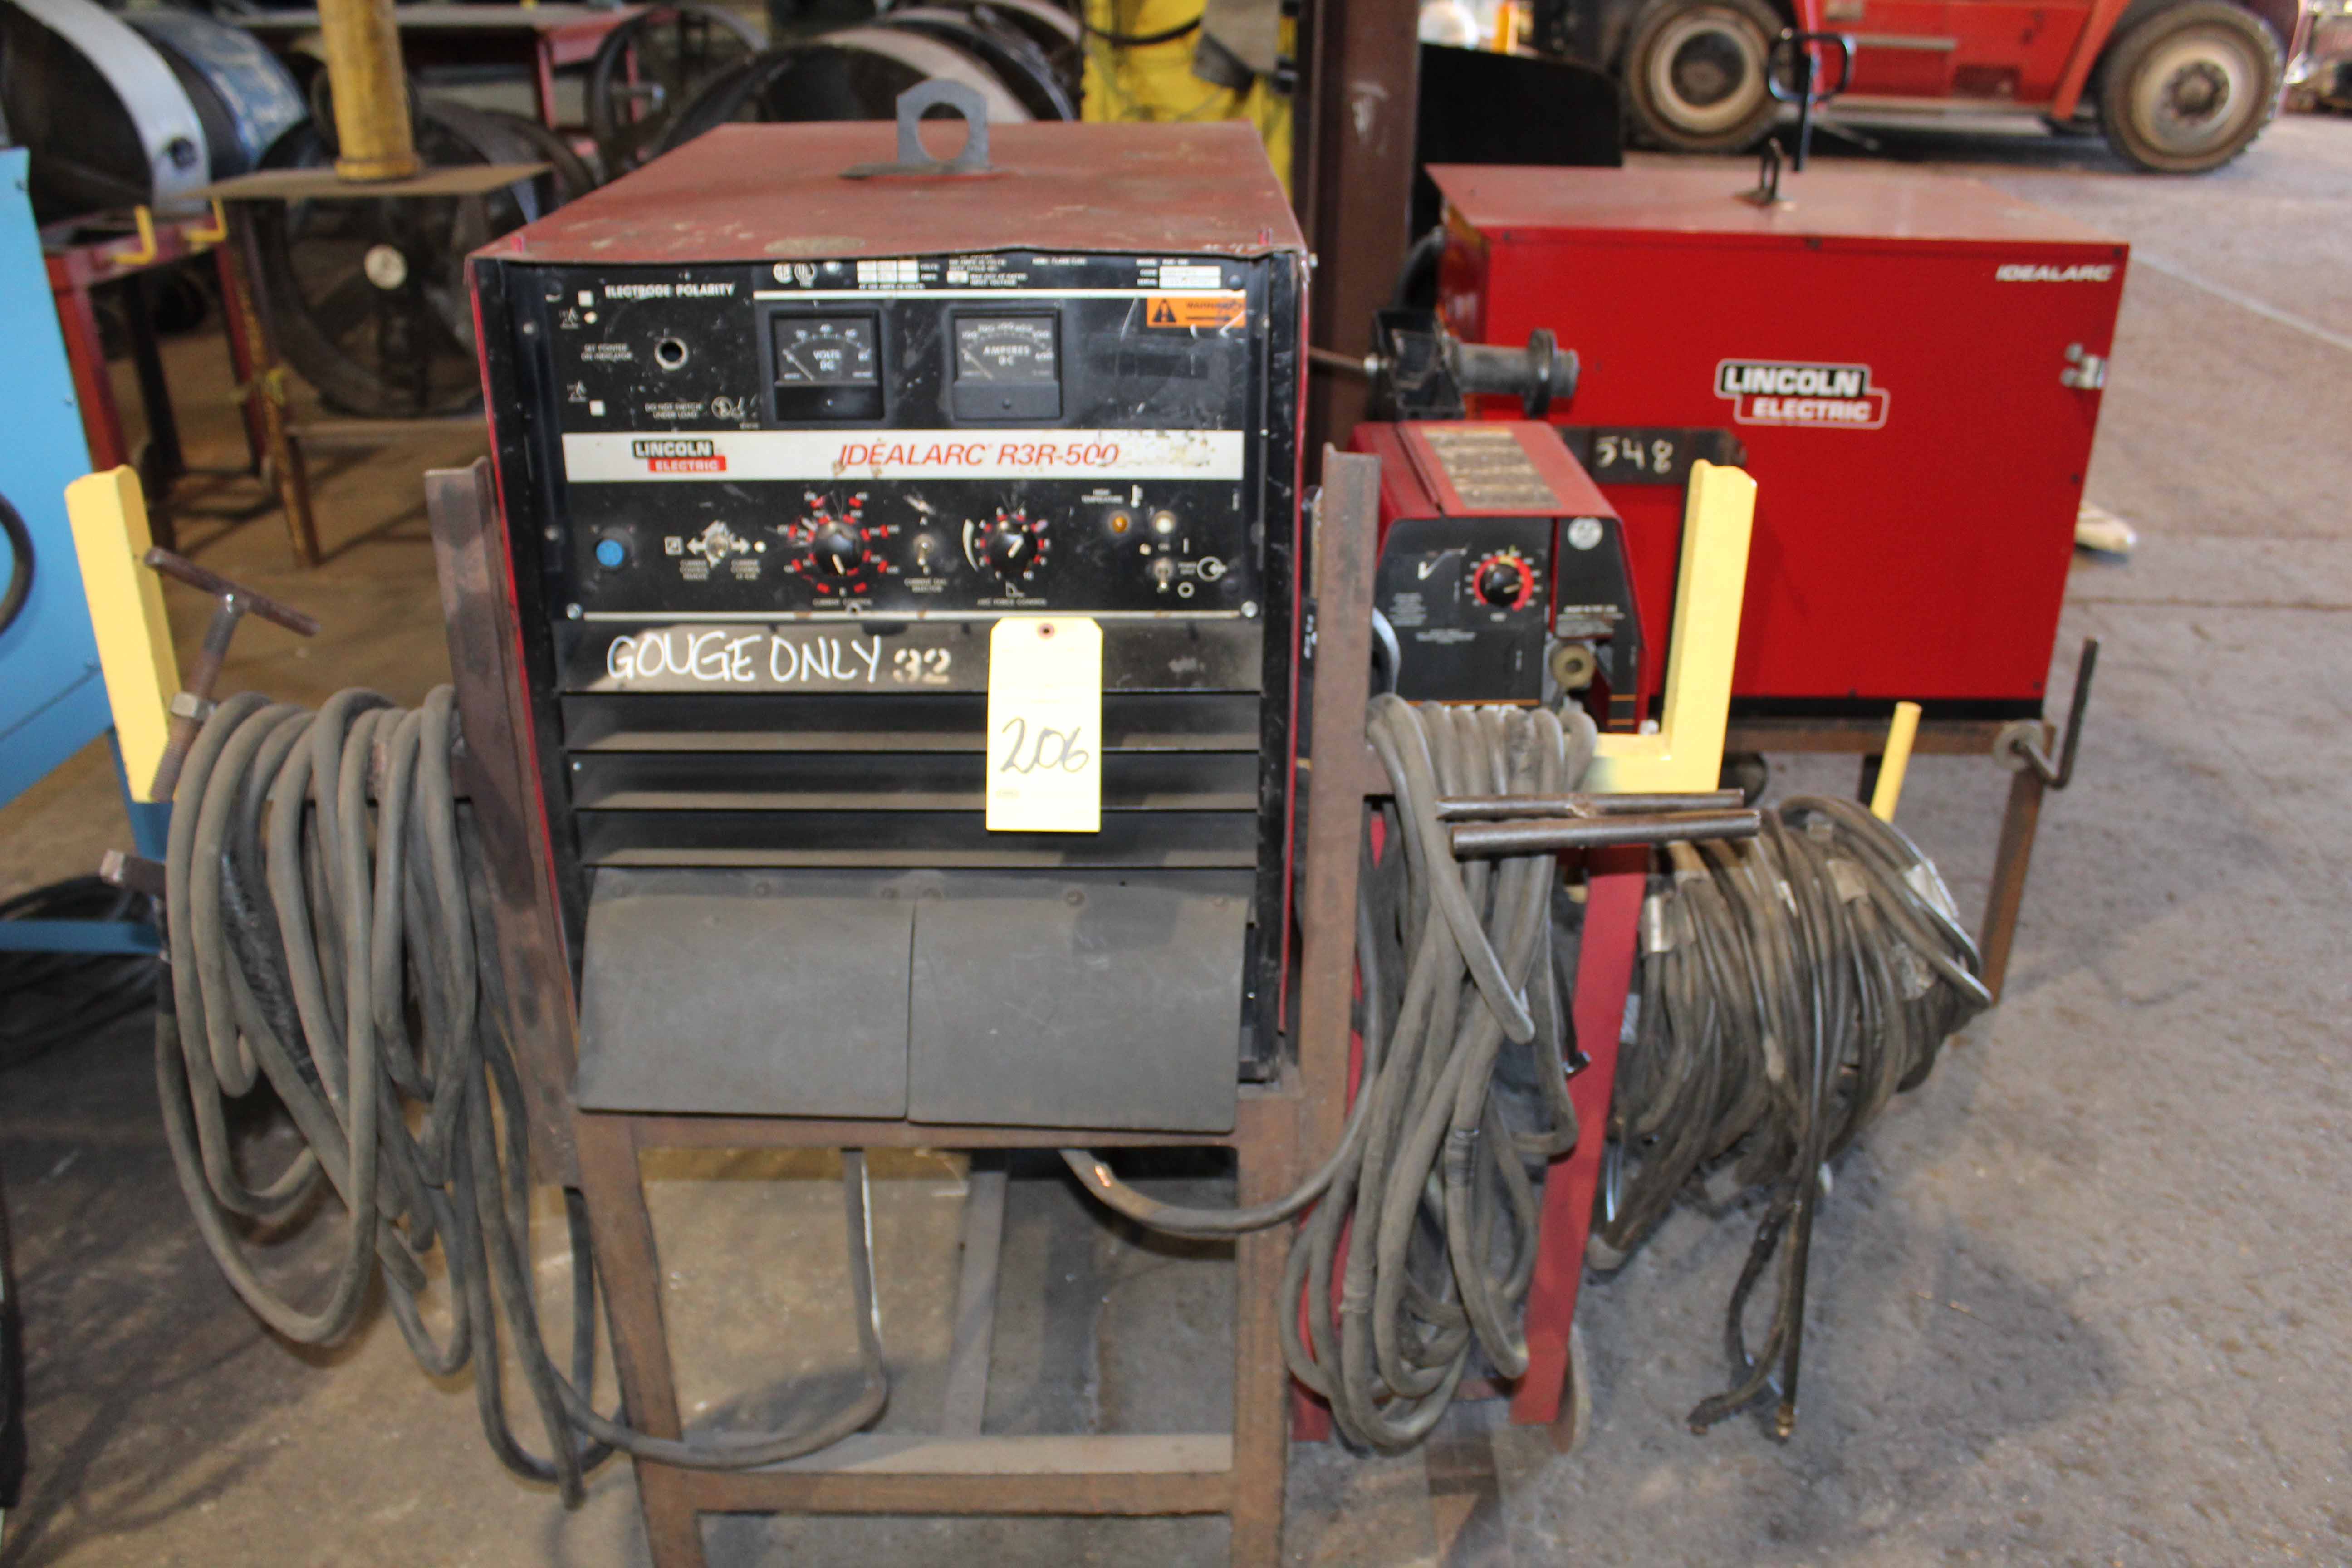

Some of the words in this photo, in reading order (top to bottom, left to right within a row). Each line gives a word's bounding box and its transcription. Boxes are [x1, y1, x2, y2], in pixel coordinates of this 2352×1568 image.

[1995, 264, 2116, 282] IDEALARC
[604, 284, 672, 299] ELECTRODE
[676, 283, 735, 298] POLARITY
[813, 349, 842, 360] VOLTS
[820, 360, 835, 371] DC
[1724, 366, 1861, 397] LINCOLN
[1752, 397, 1872, 422] ELECTRIC
[635, 441, 712, 457] LINCOLN
[838, 443, 985, 466] IDEALARC
[997, 443, 1120, 466] R3R-500
[1595, 435, 1674, 474] 548
[654, 459, 720, 471] ELECTRIC
[606, 631, 763, 681] GOUGE
[770, 634, 882, 683] ONLY
[892, 647, 952, 684] 32
[1000, 717, 1089, 774] 206
